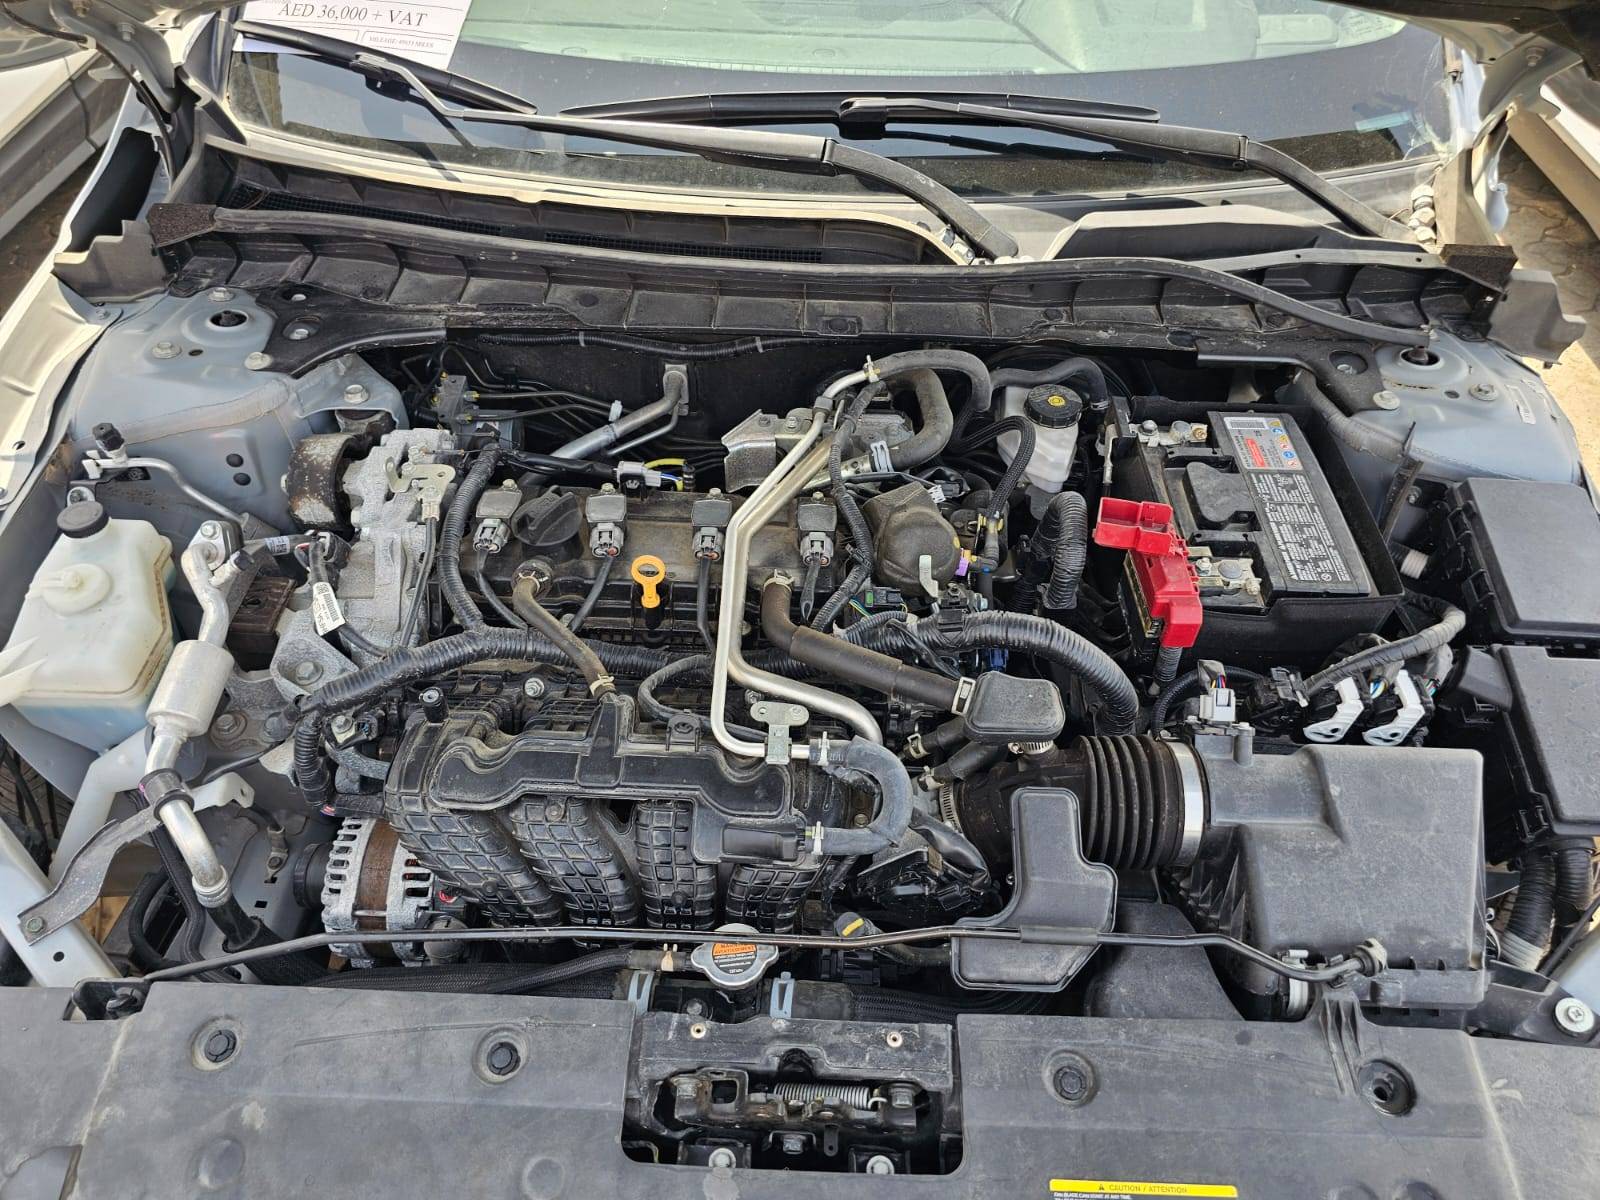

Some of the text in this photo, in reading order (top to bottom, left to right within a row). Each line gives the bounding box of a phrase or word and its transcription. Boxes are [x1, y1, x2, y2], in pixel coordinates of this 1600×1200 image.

[278, 3, 428, 26] AED 36,000 + VAT
[1109, 1184, 1141, 1192] CAUTION
[1148, 1185, 1188, 1194] ATTENTION
